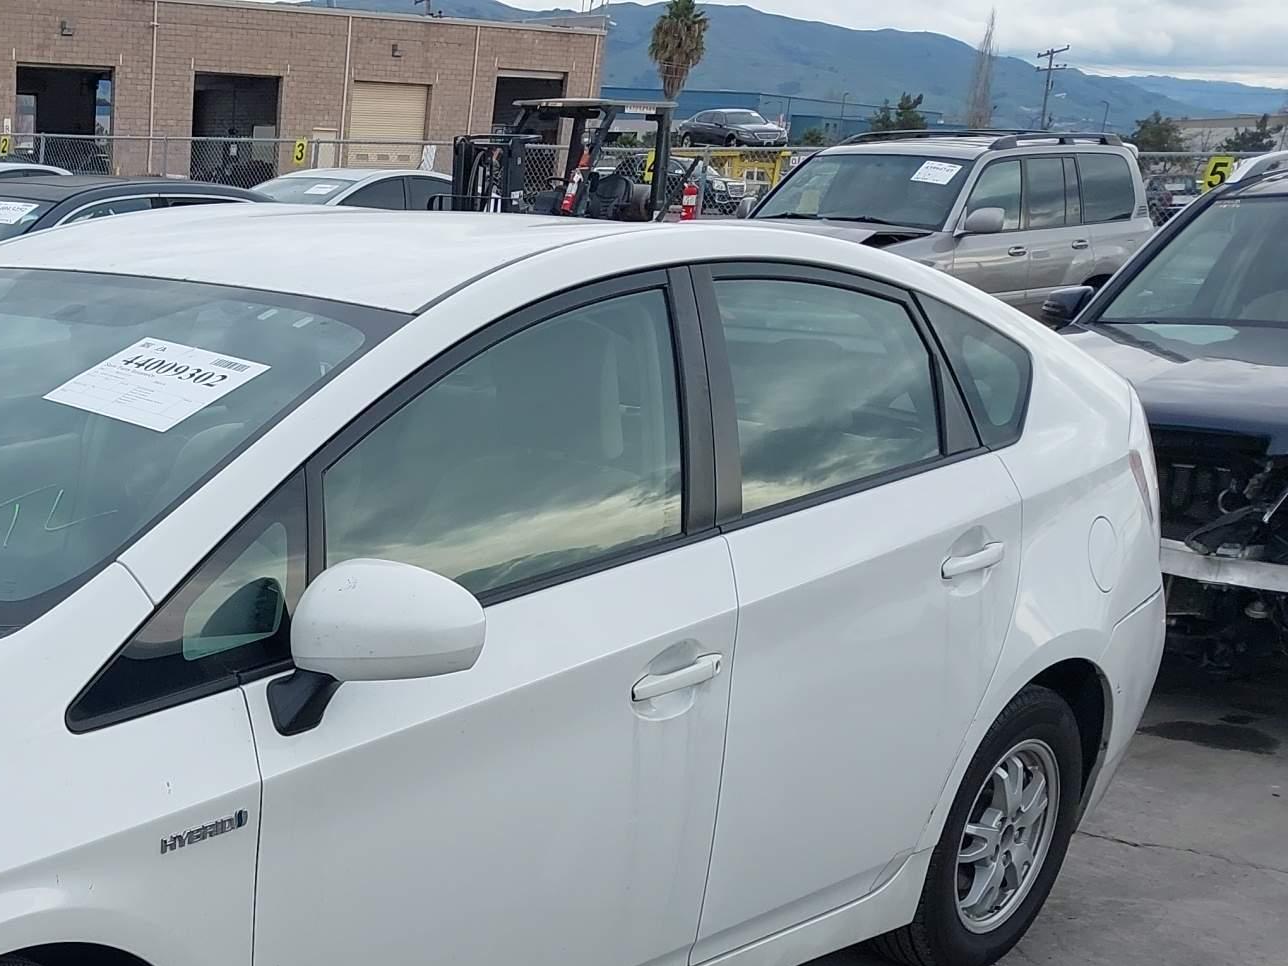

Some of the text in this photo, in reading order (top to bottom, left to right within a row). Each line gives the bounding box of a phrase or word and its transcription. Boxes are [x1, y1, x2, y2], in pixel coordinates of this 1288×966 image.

[1, 138, 8, 154] 2
[295, 142, 305, 162] 3
[1207, 162, 1228, 188] 5
[122, 354, 229, 388] 44009302
[160, 816, 236, 854] HYBRID
